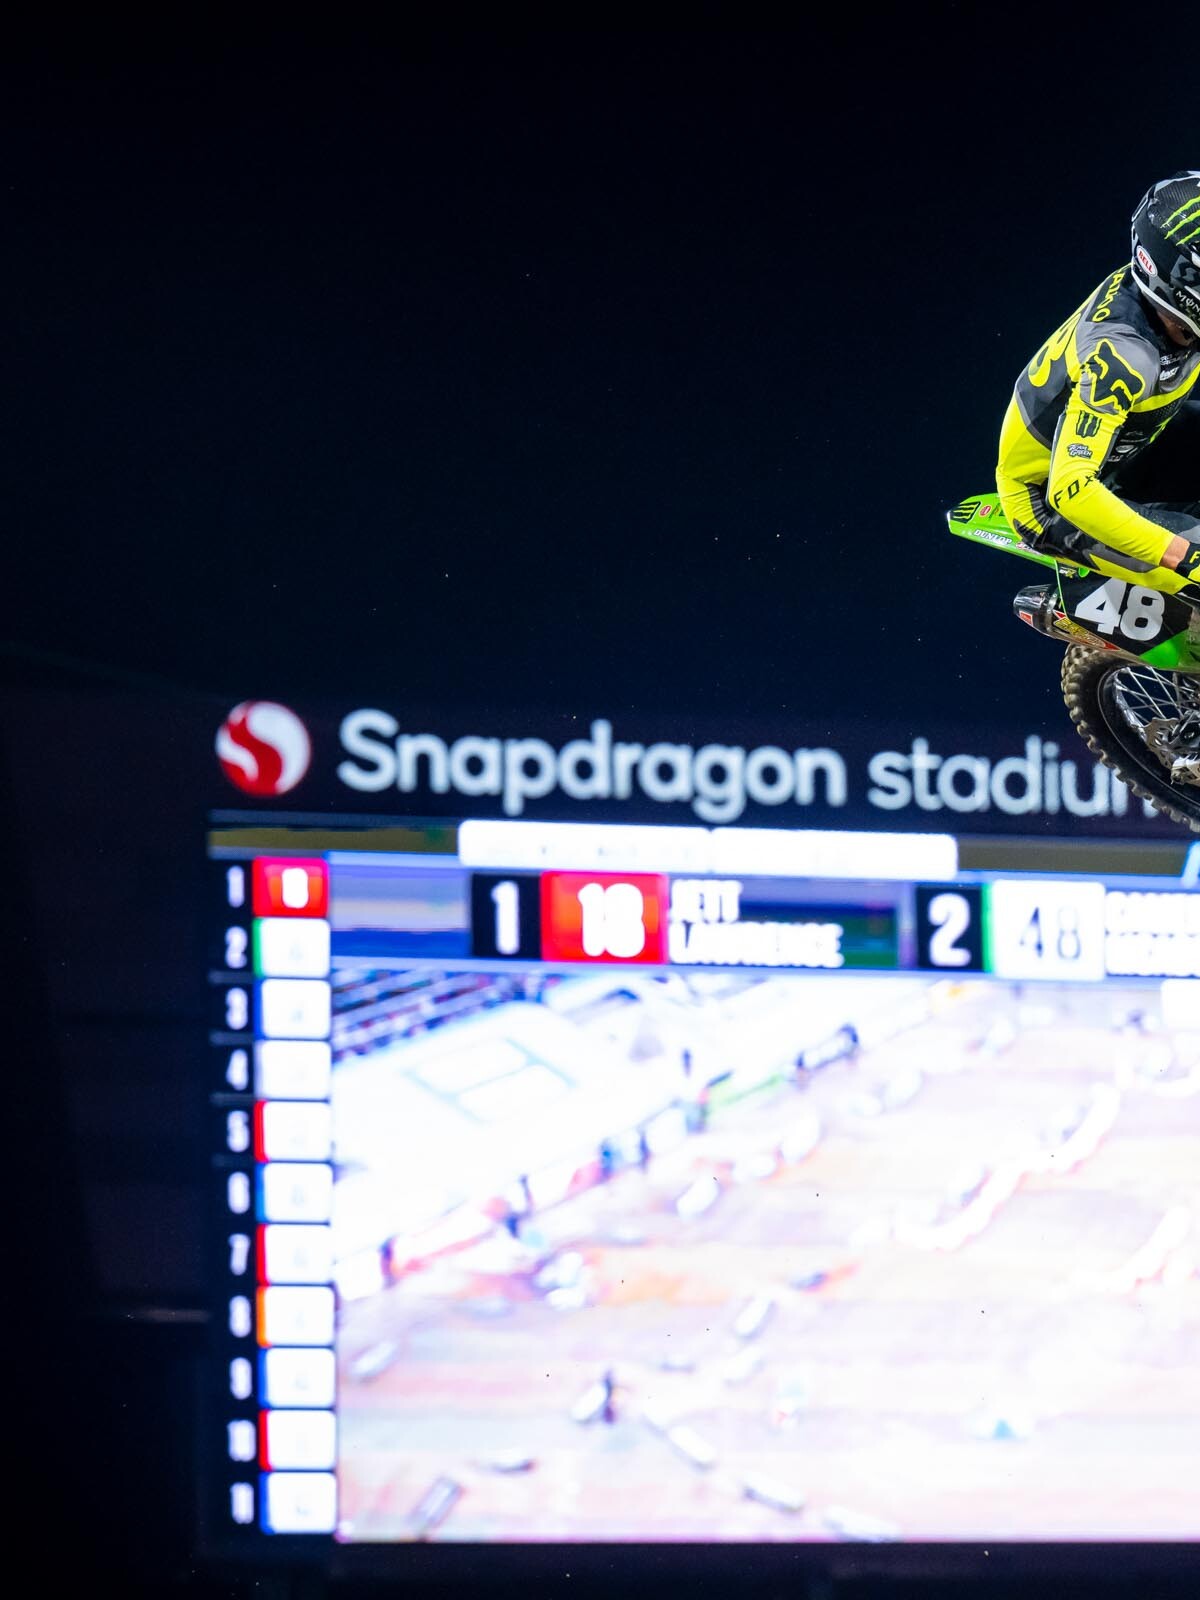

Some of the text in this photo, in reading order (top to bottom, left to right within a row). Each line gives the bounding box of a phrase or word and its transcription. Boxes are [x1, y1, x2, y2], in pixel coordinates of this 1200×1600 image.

[1137, 250, 1154, 274] BELL
[1053, 470, 1098, 509] FOX
[973, 528, 1013, 545] DUNLOP
[1074, 577, 1166, 642] 48
[337, 708, 847, 823] Snapdragon
[491, 881, 520, 956] 1
[928, 893, 971, 967] 2
[1018, 904, 1082, 962] 48
